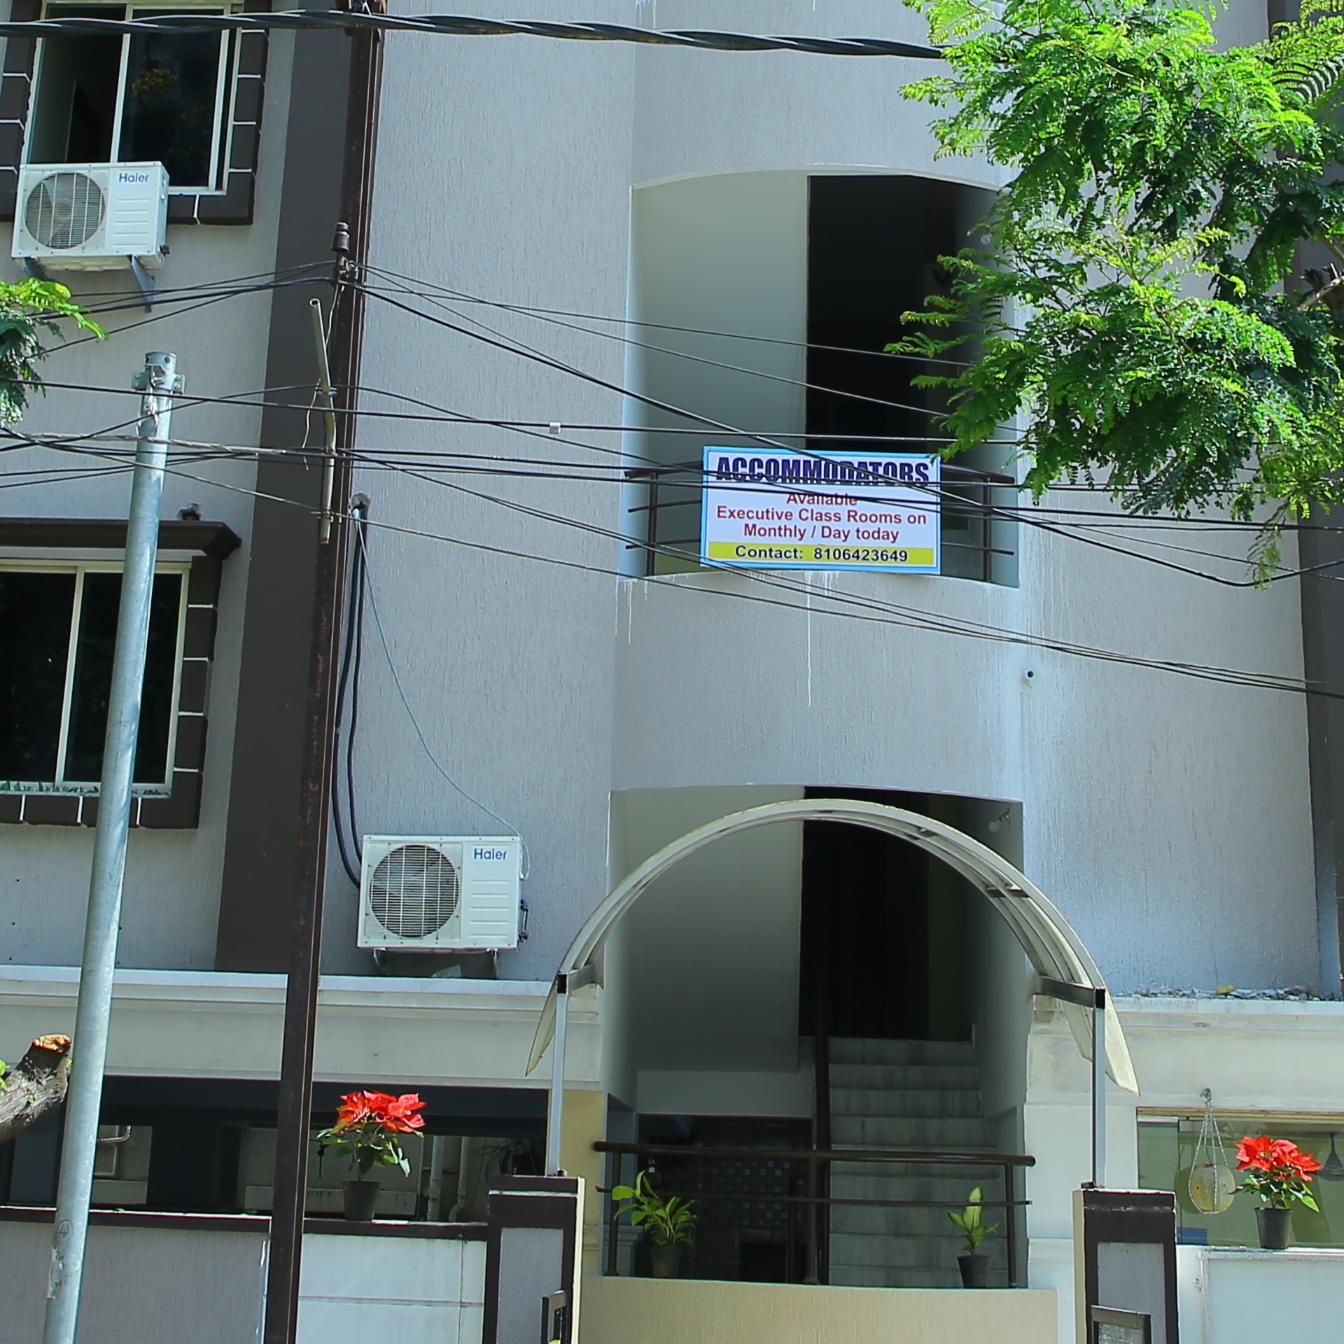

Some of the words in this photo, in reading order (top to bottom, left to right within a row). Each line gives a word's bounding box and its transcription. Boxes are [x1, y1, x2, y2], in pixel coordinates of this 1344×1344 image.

[118, 172, 149, 183] Haier
[716, 457, 930, 488] ACCOMMODATORS
[786, 492, 858, 506] Available
[716, 505, 793, 522] Executive
[798, 507, 841, 523] Class
[846, 509, 902, 524] Rooms
[907, 513, 927, 525] on
[743, 523, 806, 539] Monthly
[810, 525, 817, 539] /
[820, 525, 851, 542] Day
[855, 527, 899, 543] today
[735, 544, 803, 559] Contact:
[813, 547, 908, 562] 8106423649
[473, 847, 508, 860] Haier
